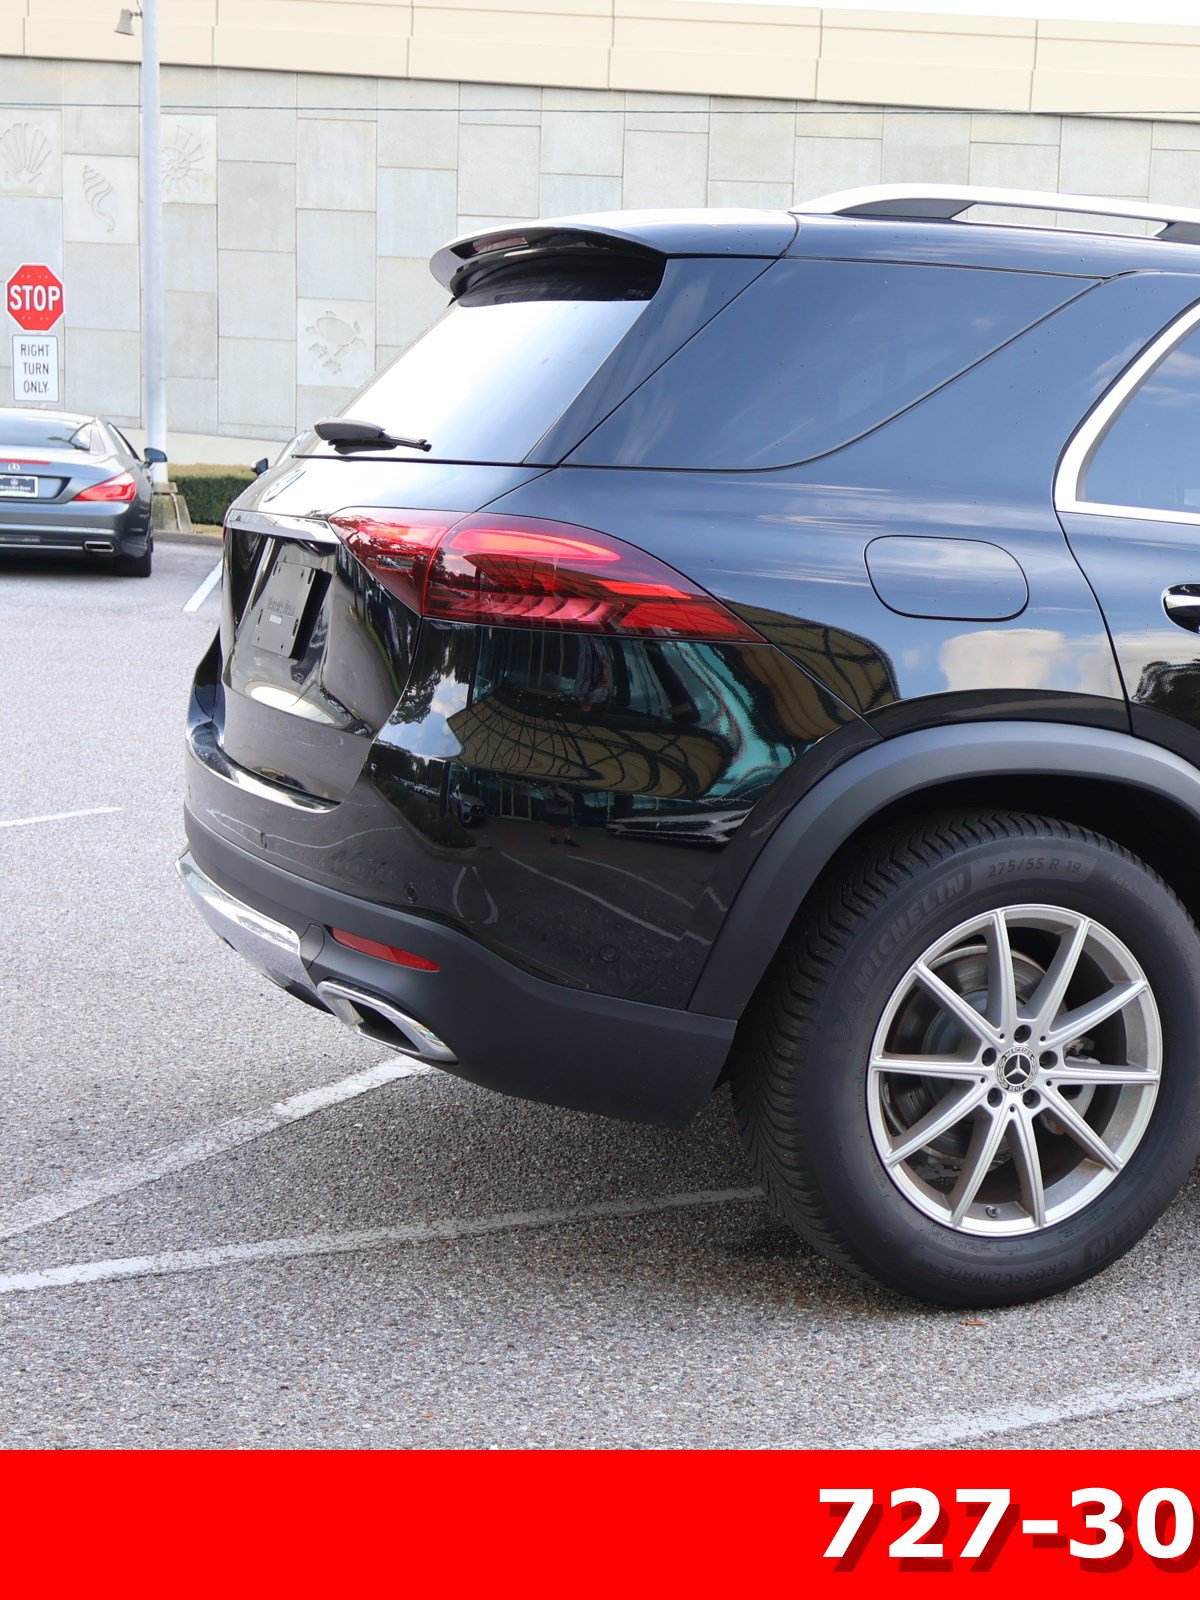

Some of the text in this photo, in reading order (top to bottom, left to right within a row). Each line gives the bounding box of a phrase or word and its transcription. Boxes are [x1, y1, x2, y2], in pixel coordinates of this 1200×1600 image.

[9, 285, 61, 311] STOP
[20, 344, 50, 357] RIGHT
[23, 362, 49, 375] TURN
[23, 381, 49, 393] ONLY
[989, 857, 1082, 878] 275/55 R 19
[852, 872, 966, 994] MICHELIN
